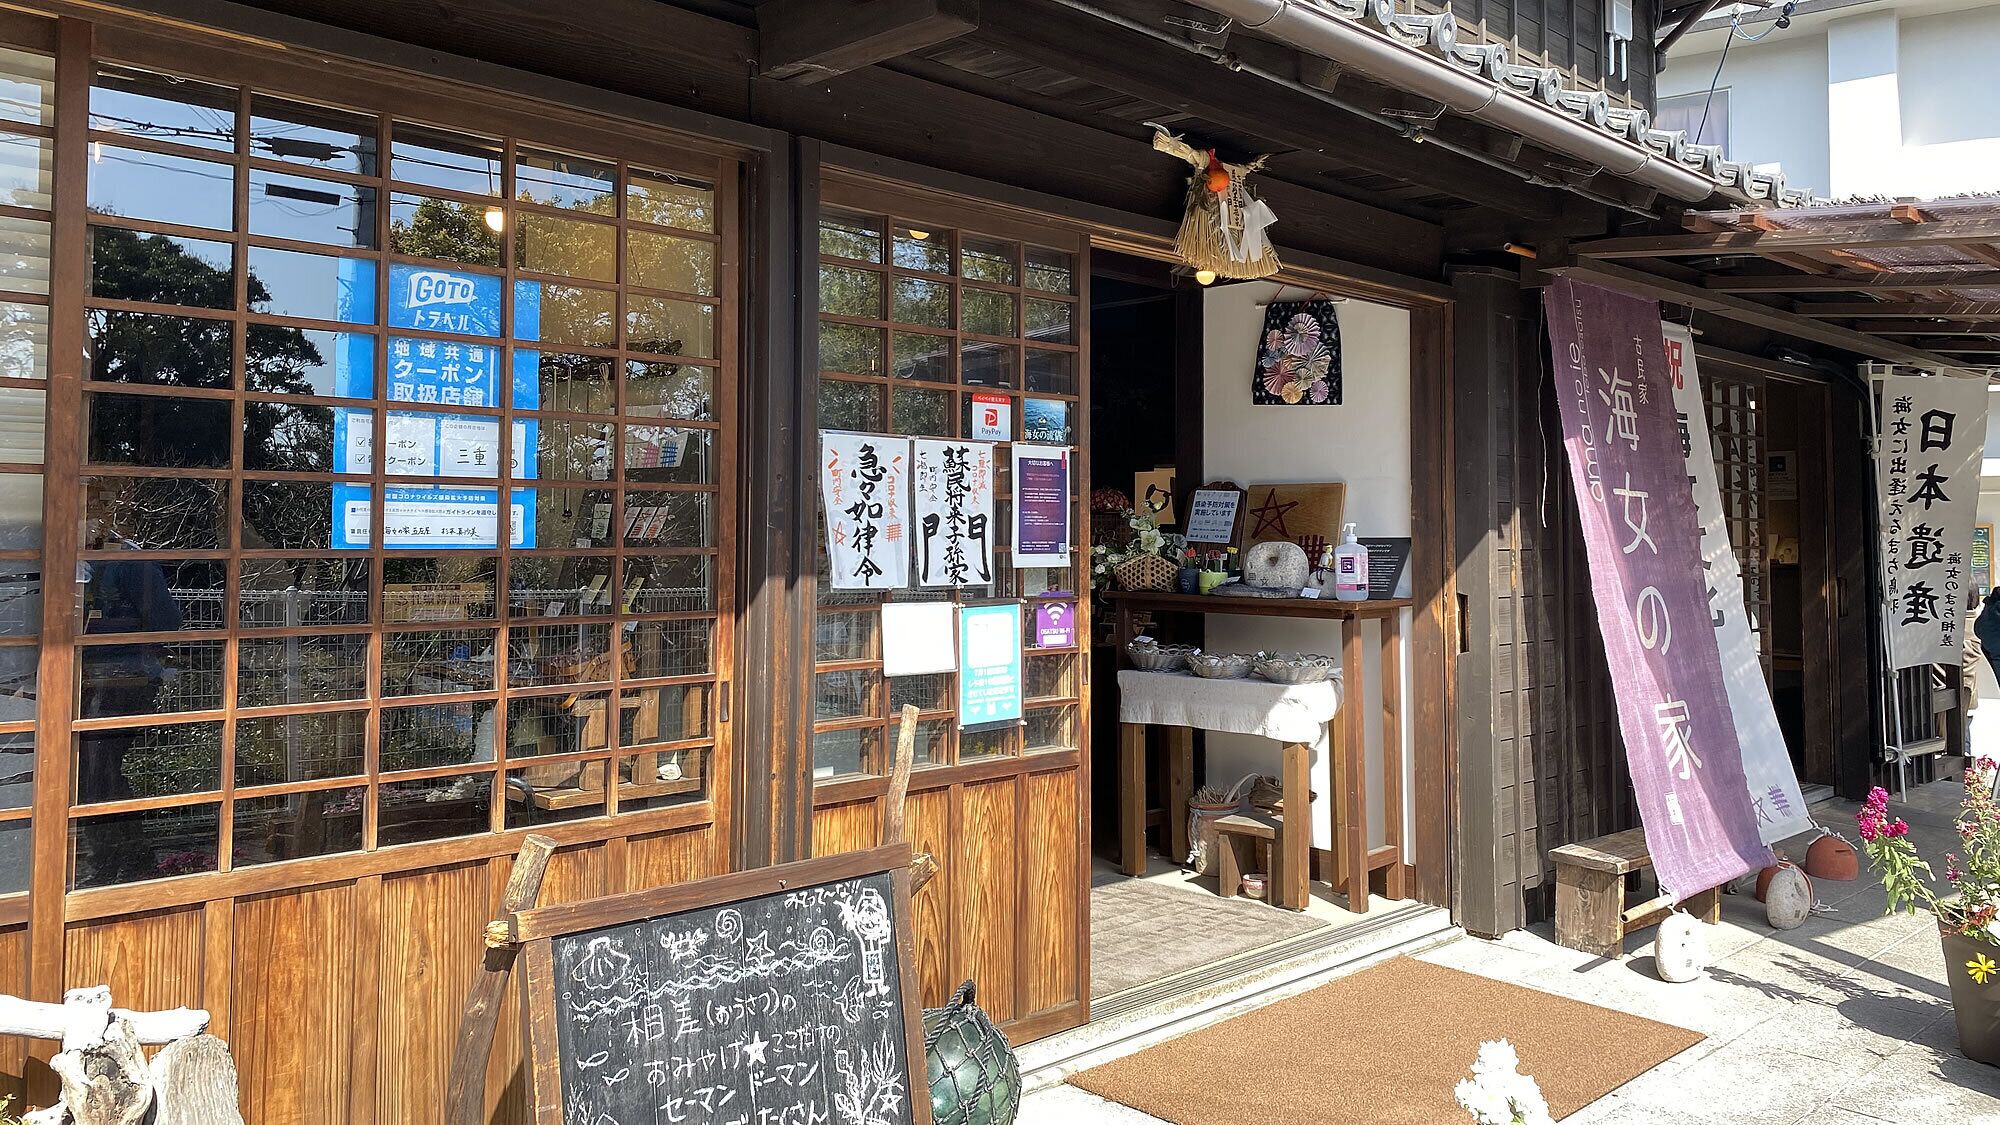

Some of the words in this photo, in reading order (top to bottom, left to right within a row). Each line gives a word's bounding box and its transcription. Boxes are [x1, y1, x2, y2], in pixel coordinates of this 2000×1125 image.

[413, 311, 469, 329] トラベル
[394, 341, 483, 362] 地域共通
[1568, 342, 1581, 370] ie
[395, 360, 484, 383] クーポン
[394, 382, 484, 407] 取扱店舗
[1575, 380, 1587, 414] no
[981, 428, 1001, 436] PayPay
[457, 446, 487, 467] 三重
[1582, 425, 1604, 503] ama
[1598, 367, 1702, 780] 海女の家
